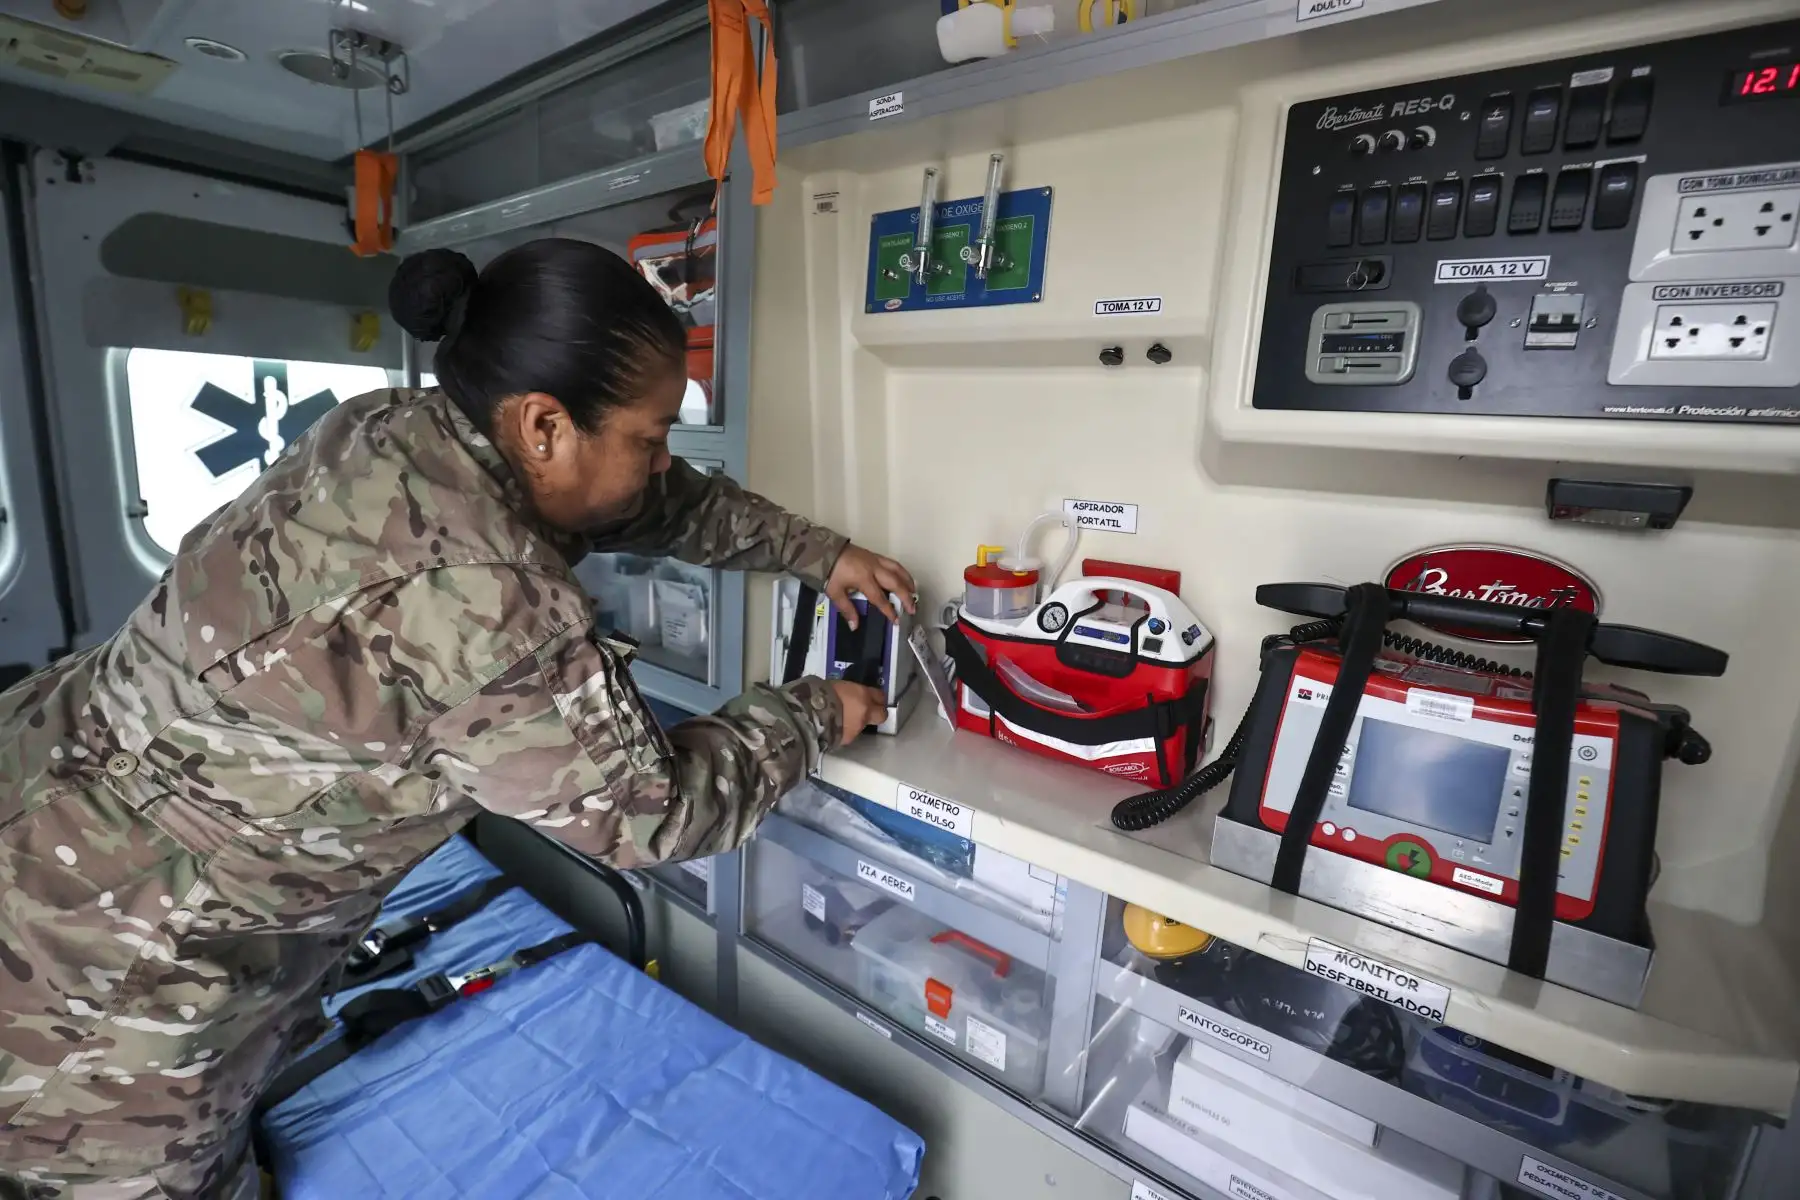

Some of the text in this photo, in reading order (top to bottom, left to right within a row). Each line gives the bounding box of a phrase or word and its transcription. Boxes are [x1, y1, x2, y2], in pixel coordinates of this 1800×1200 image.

[870, 104, 903, 116] ASPIRACION
[876, 96, 895, 105] SONDA
[1316, 94, 1455, 130] Bertonati RES-Q
[942, 208, 953, 217] DE
[1451, 262, 1534, 277] TOMA 12 V
[1659, 284, 1776, 298] CON INVERSOR
[1103, 301, 1153, 312] TOMA 12 V
[1678, 405, 1746, 416] Protección
[1073, 502, 1124, 514] ASPIRADOR
[1077, 515, 1122, 528] PORTATIL
[909, 790, 960, 816] OXIMETRO
[911, 806, 956, 830] DE PULSO
[859, 863, 913, 895] VIA AEREA
[1334, 951, 1419, 992] MONITOR
[1306, 959, 1443, 1022] DESFIBRILADOR
[1180, 1009, 1270, 1055] PANTOSCOPIO
[1523, 1171, 1582, 1200] PEDIATRICO
[1536, 1165, 1605, 1198] OXIMETRO DE
